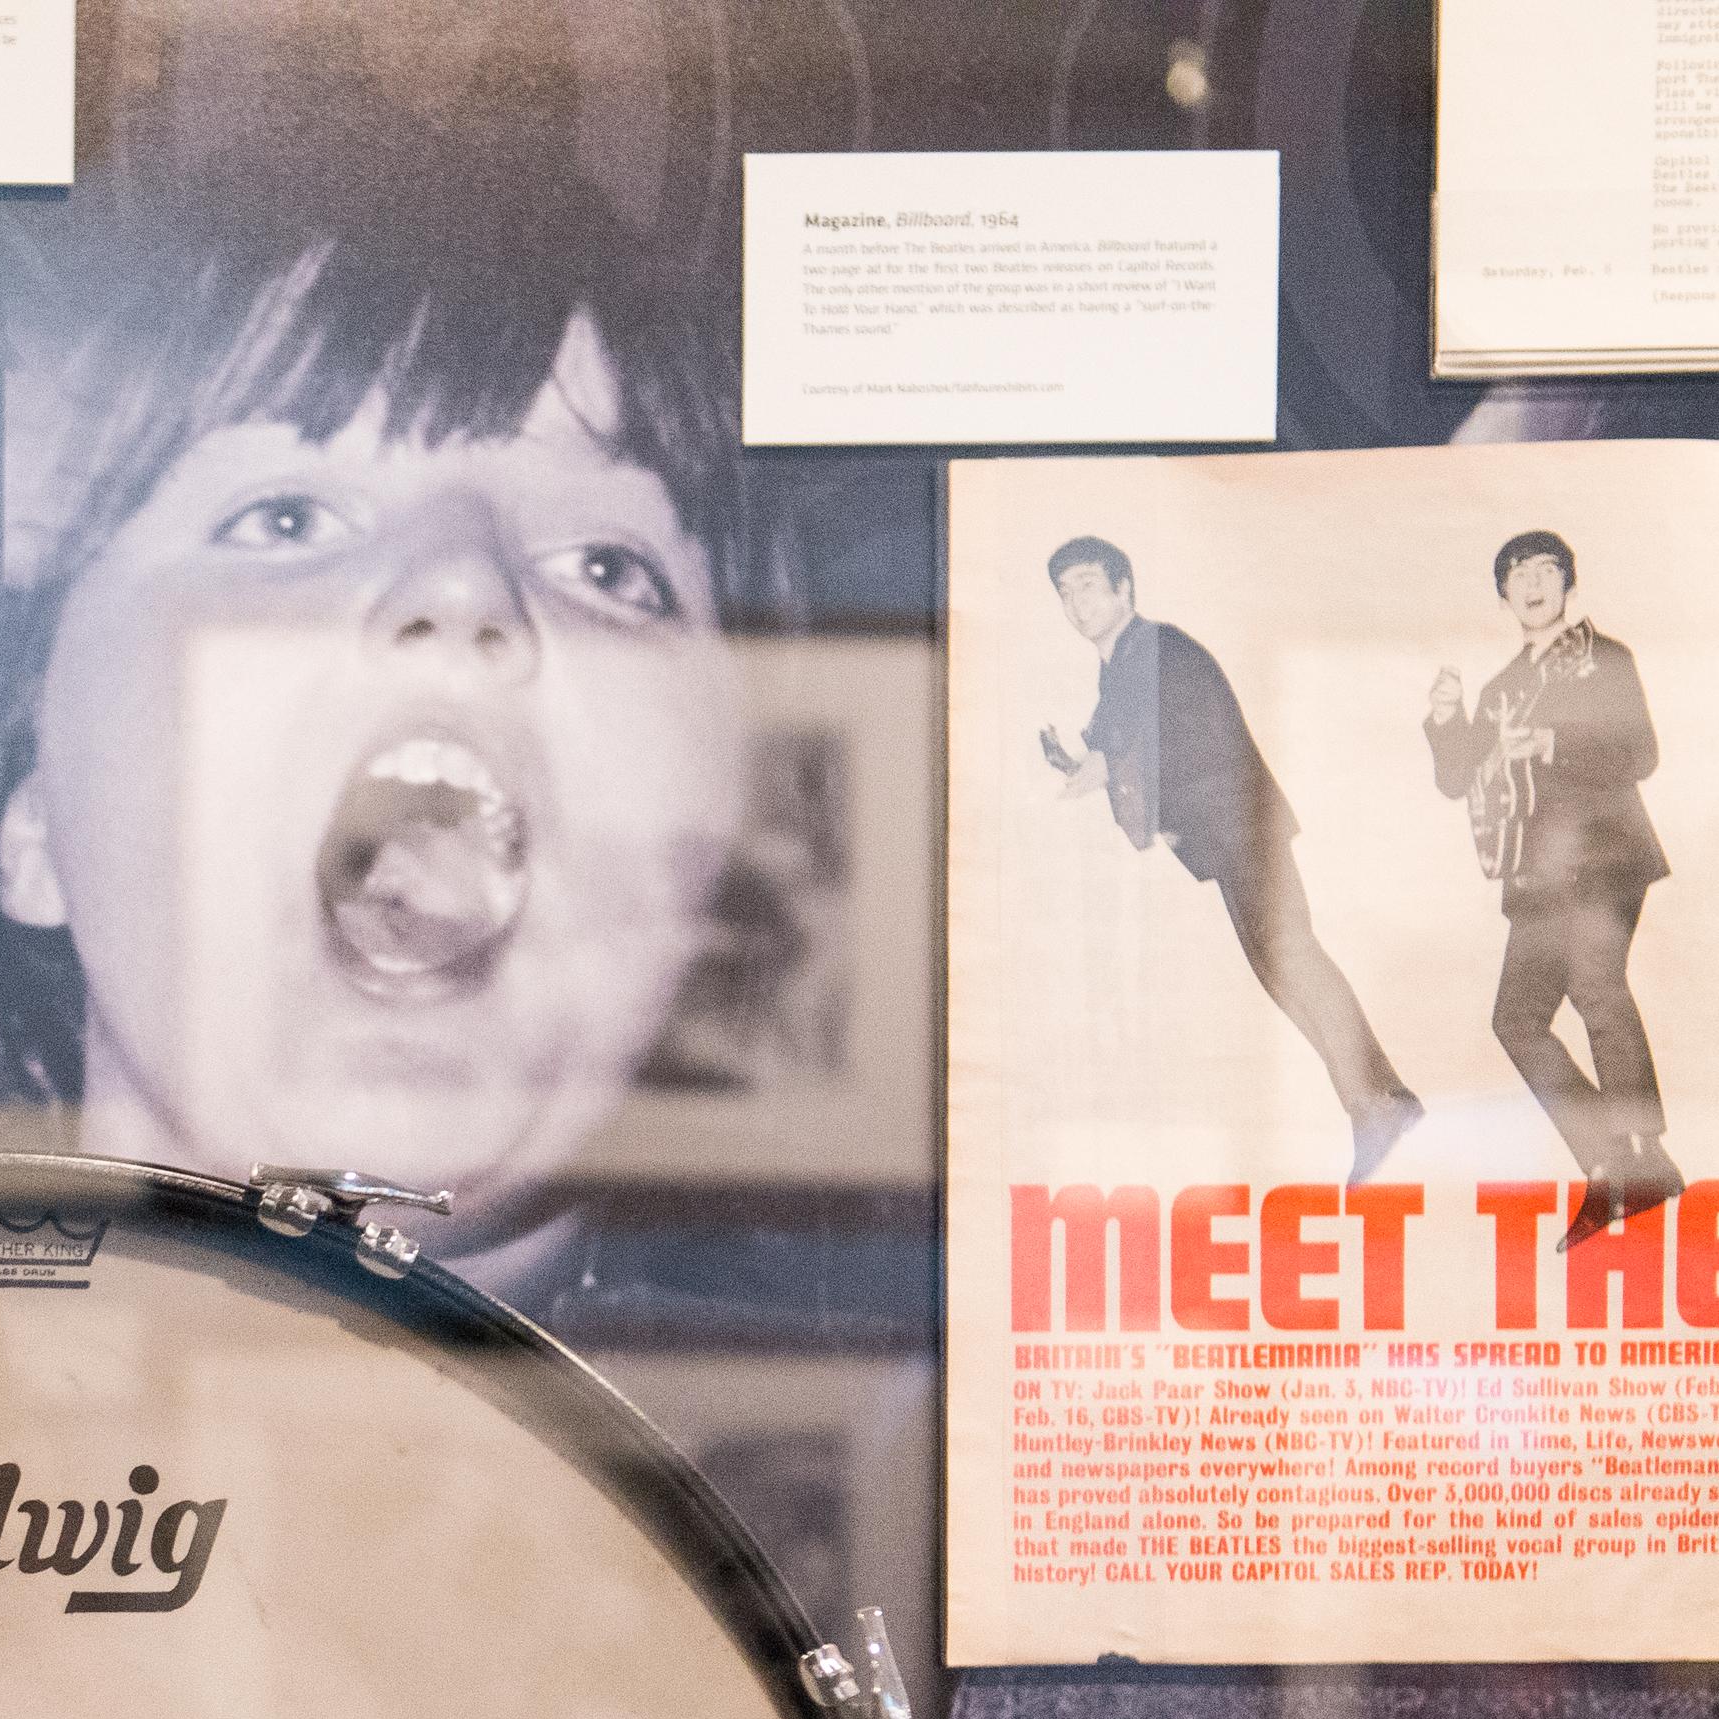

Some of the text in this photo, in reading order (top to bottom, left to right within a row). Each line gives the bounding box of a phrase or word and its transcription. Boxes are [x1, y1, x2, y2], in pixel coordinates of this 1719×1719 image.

[803, 212, 1019, 232] Magazine, Billboard, 1964
[43, 1243, 84, 1258] KING
[1009, 1183, 1424, 1332] MEET
[23, 1267, 56, 1276] DRUM
[1014, 1343, 1145, 1370] BRITAIN'S
[1155, 1342, 1376, 1369] "BEATLEMANIA"
[1387, 1342, 1439, 1366] HAS
[1453, 1341, 1561, 1367] SPREAD
[1574, 1340, 1607, 1367] TO
[1012, 1380, 1042, 1402] ON
[1052, 1380, 1083, 1400] TV:
[1092, 1380, 1142, 1399] Jack
[1153, 1380, 1204, 1400] Paar
[1213, 1379, 1272, 1401] Show
[1280, 1379, 1335, 1401] (Jan.
[1345, 1379, 1363, 1401] 3,
[1370, 1378, 1465, 1399] NBC-TV)!
[1476, 1379, 1502, 1398] Ed
[1512, 1377, 1599, 1398] Sullivan
[1608, 1376, 1667, 1398] Show
[1013, 1406, 1055, 1427] Feb.
[1066, 1407, 1095, 1428] 16,
[1101, 1404, 1201, 1427] CBS-TV)!
[1208, 1404, 1290, 1430] Already
[1299, 1409, 1349, 1425] seen
[1358, 1409, 1384, 1425] on
[1393, 1405, 1465, 1424] Walter
[1475, 1404, 1570, 1424] Cronkite
[1579, 1403, 1637, 1424] News
[1013, 1429, 1719, 1456] Huntley-Brinkley News (NBC-TV)! Featured in Time, Life, Newsw
[1014, 1532, 1718, 1559] that made THE BEATLES the biggest-selling vocal group in Brit
[1013, 1557, 1538, 1585] history! CALL YOUR CAPITOL SALES REP. TODAY!
